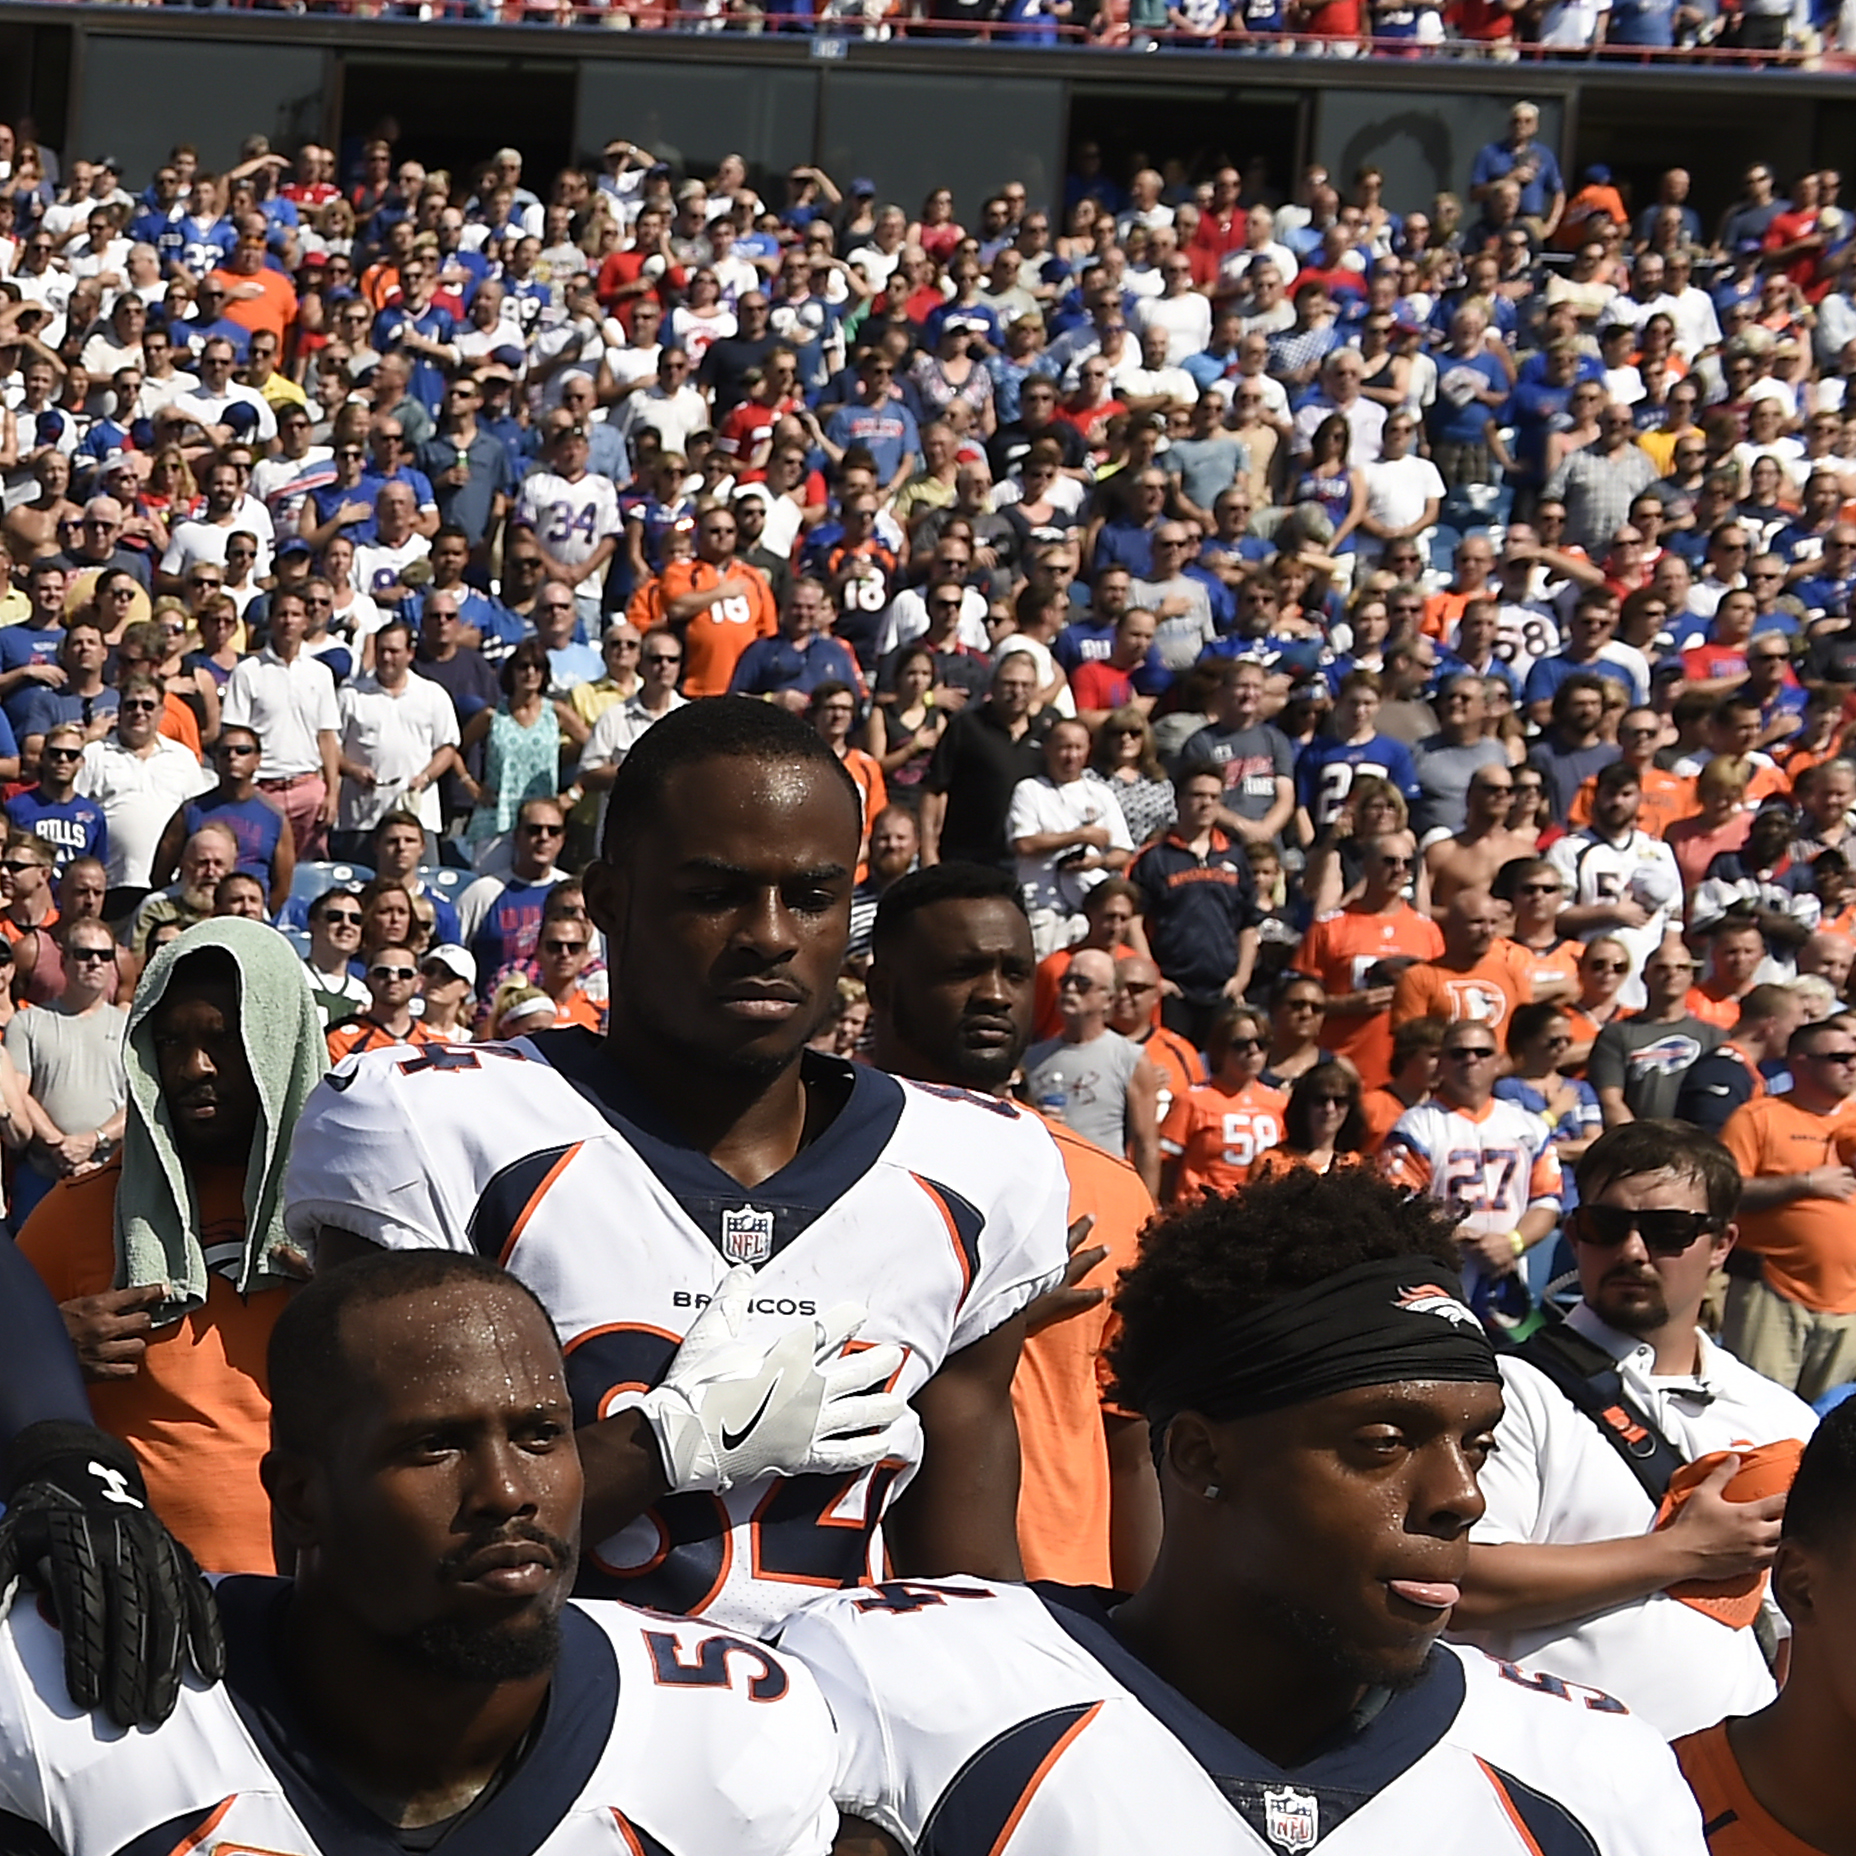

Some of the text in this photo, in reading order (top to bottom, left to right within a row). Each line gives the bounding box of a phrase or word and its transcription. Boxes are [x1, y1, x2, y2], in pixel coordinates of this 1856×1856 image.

[547, 502, 598, 546] 34
[35, 818, 89, 850] BILLS
[1448, 1149, 1518, 1212] 27
[731, 1233, 766, 1259] NFL
